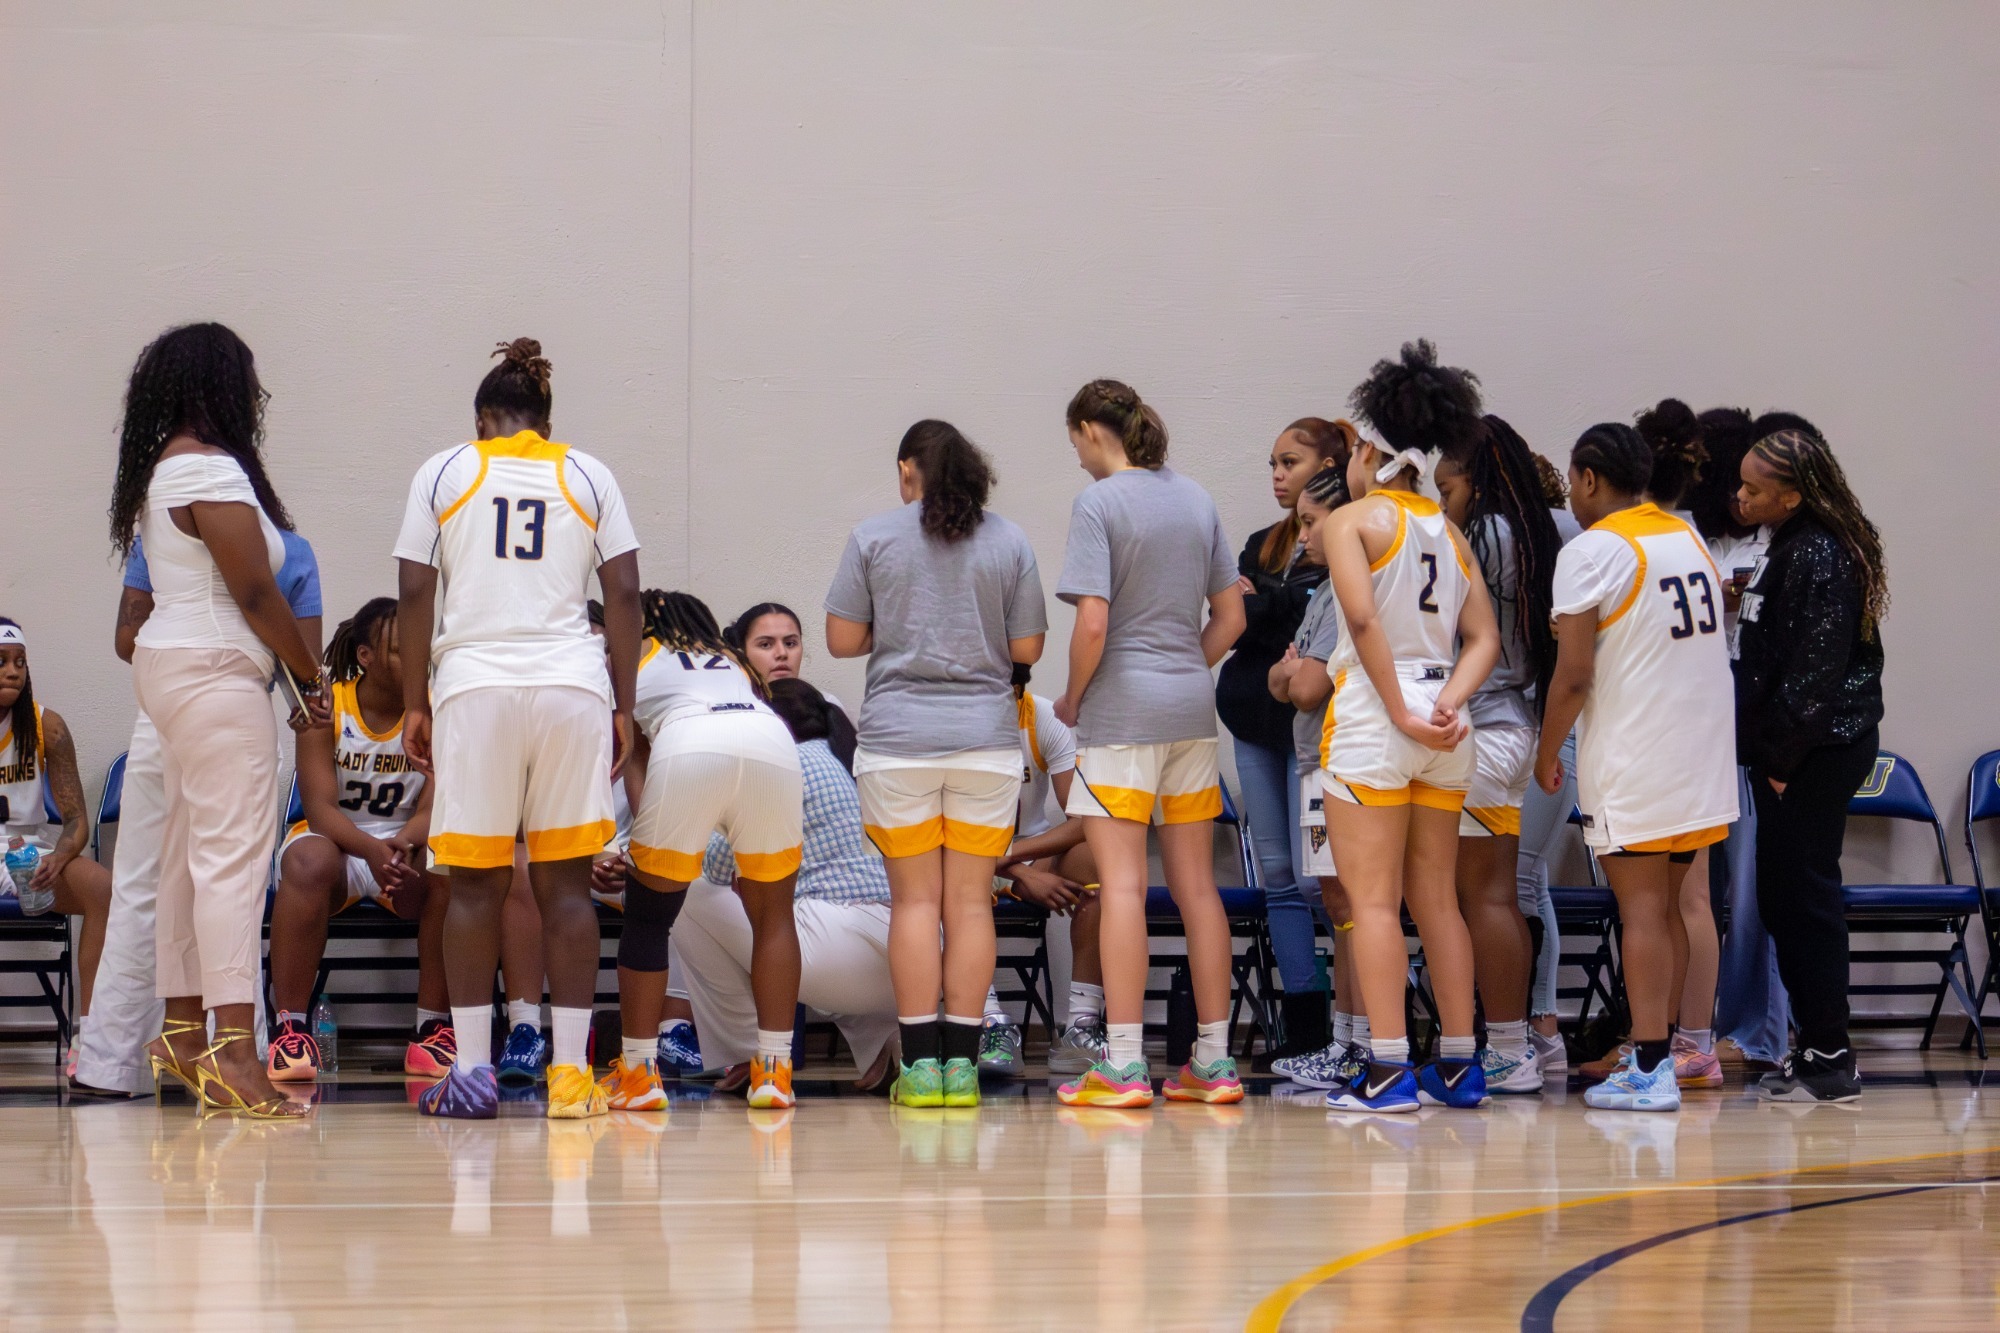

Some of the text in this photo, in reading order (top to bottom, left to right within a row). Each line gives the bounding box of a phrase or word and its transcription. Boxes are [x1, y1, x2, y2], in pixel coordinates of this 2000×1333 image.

[492, 496, 546, 560] 13
[1418, 552, 1439, 614] 2
[1659, 571, 1717, 640] 33
[373, 753, 417, 773] BRUIN
